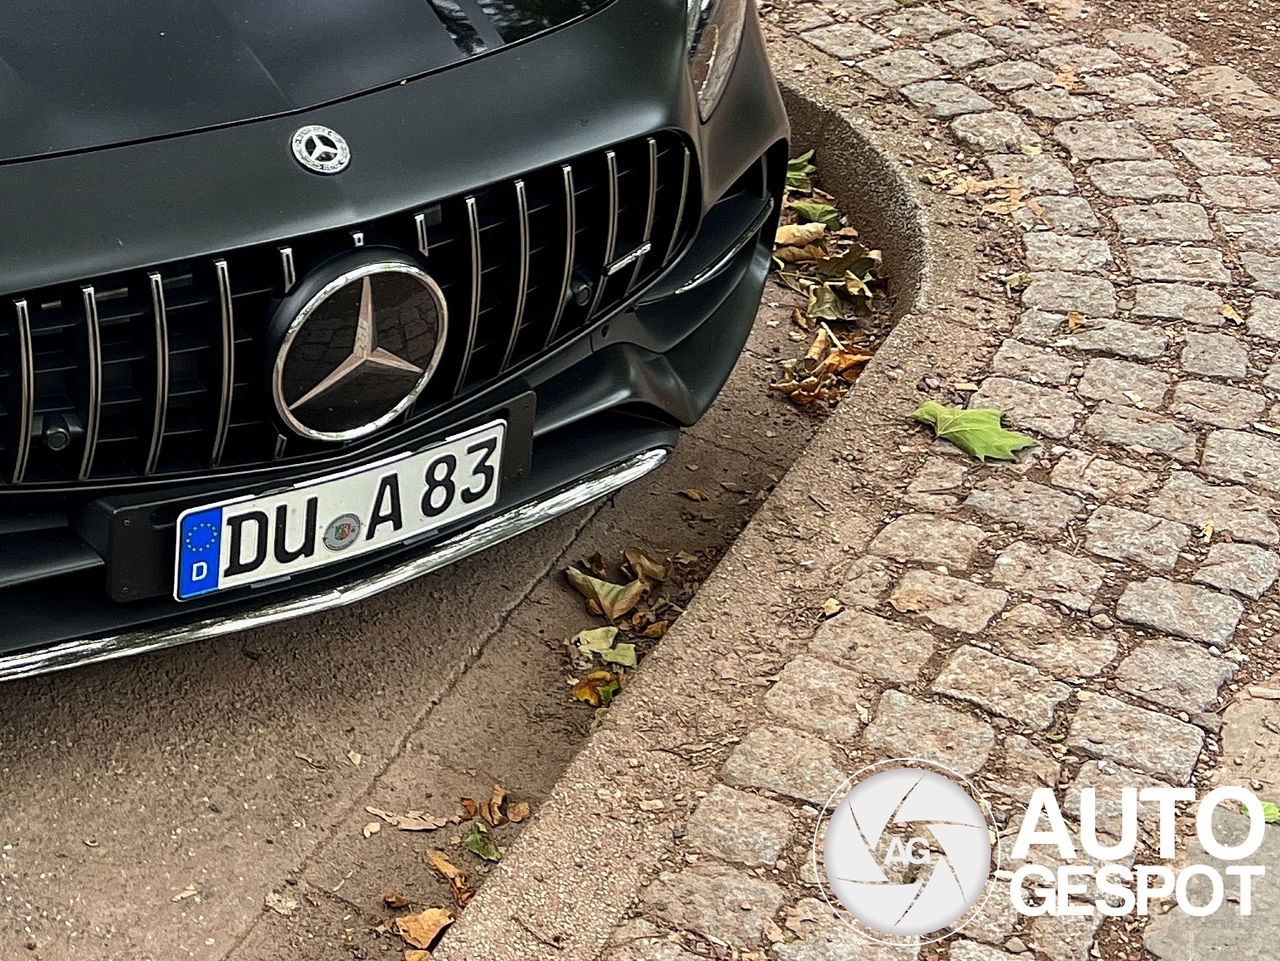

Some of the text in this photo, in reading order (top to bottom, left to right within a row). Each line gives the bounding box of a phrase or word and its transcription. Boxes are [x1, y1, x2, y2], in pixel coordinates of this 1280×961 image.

[223, 496, 318, 578] DU
[365, 472, 403, 541] A
[421, 436, 497, 518] 83
[191, 561, 208, 581] D
